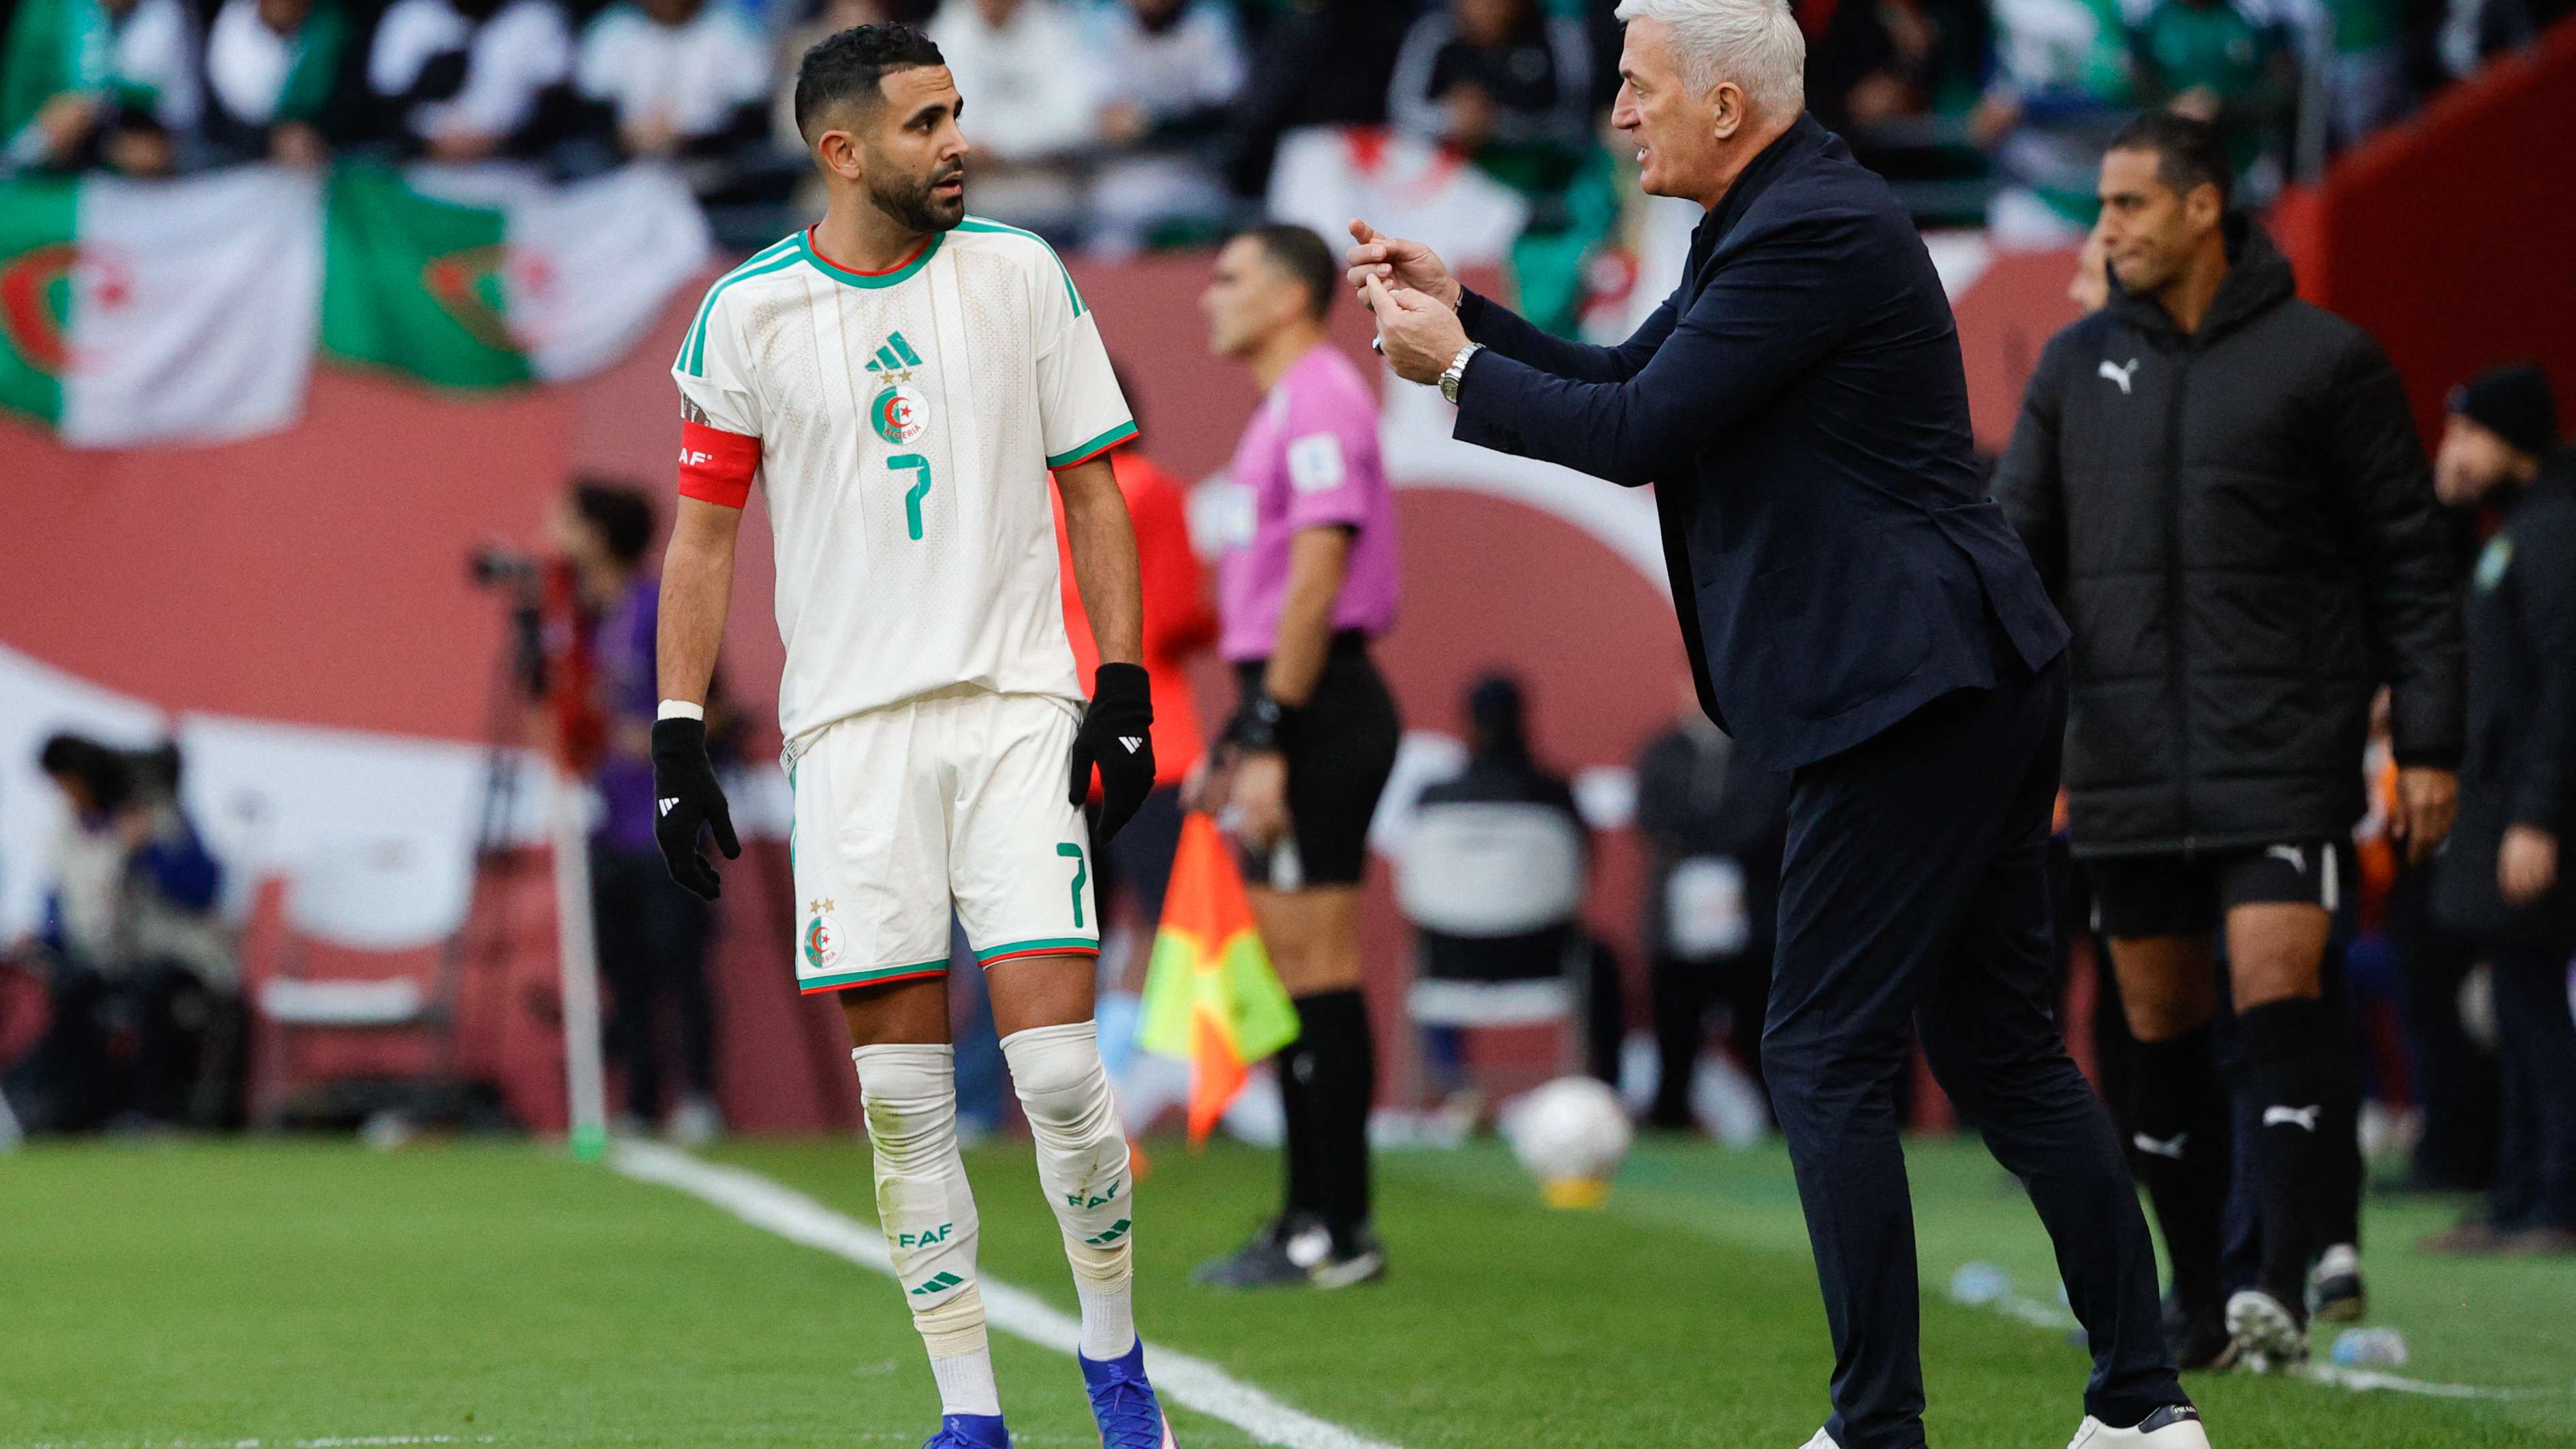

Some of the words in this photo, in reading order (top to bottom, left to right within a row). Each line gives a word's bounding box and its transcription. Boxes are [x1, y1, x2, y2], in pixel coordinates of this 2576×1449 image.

[884, 424, 922, 439] ALGERIA
[886, 453, 932, 540] 7
[1057, 843, 1087, 928] 7
[1066, 1179, 1120, 1209] FAF
[899, 1222, 952, 1249] FAF
